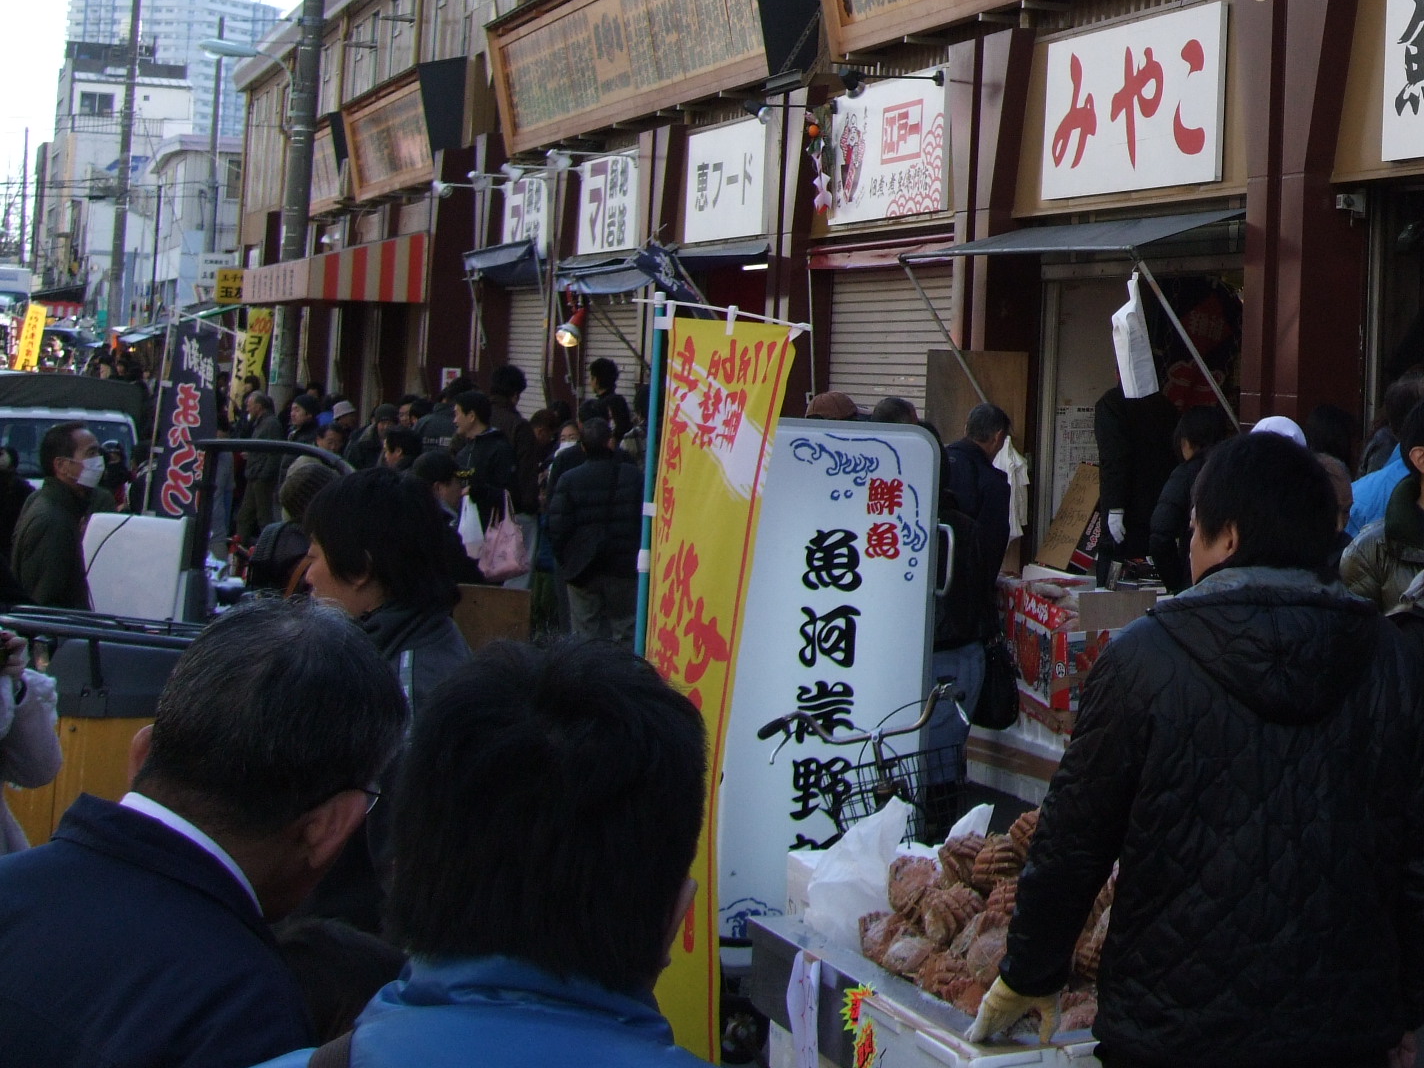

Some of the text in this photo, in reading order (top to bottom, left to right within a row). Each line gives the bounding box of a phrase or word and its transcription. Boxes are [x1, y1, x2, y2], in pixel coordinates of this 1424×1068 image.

[884, 109, 920, 155] 江戸一
[1051, 38, 1206, 171] みやこ
[694, 151, 755, 213] 恵フード
[865, 477, 903, 561] 鮮魚
[788, 529, 862, 851] 魚河岸野
